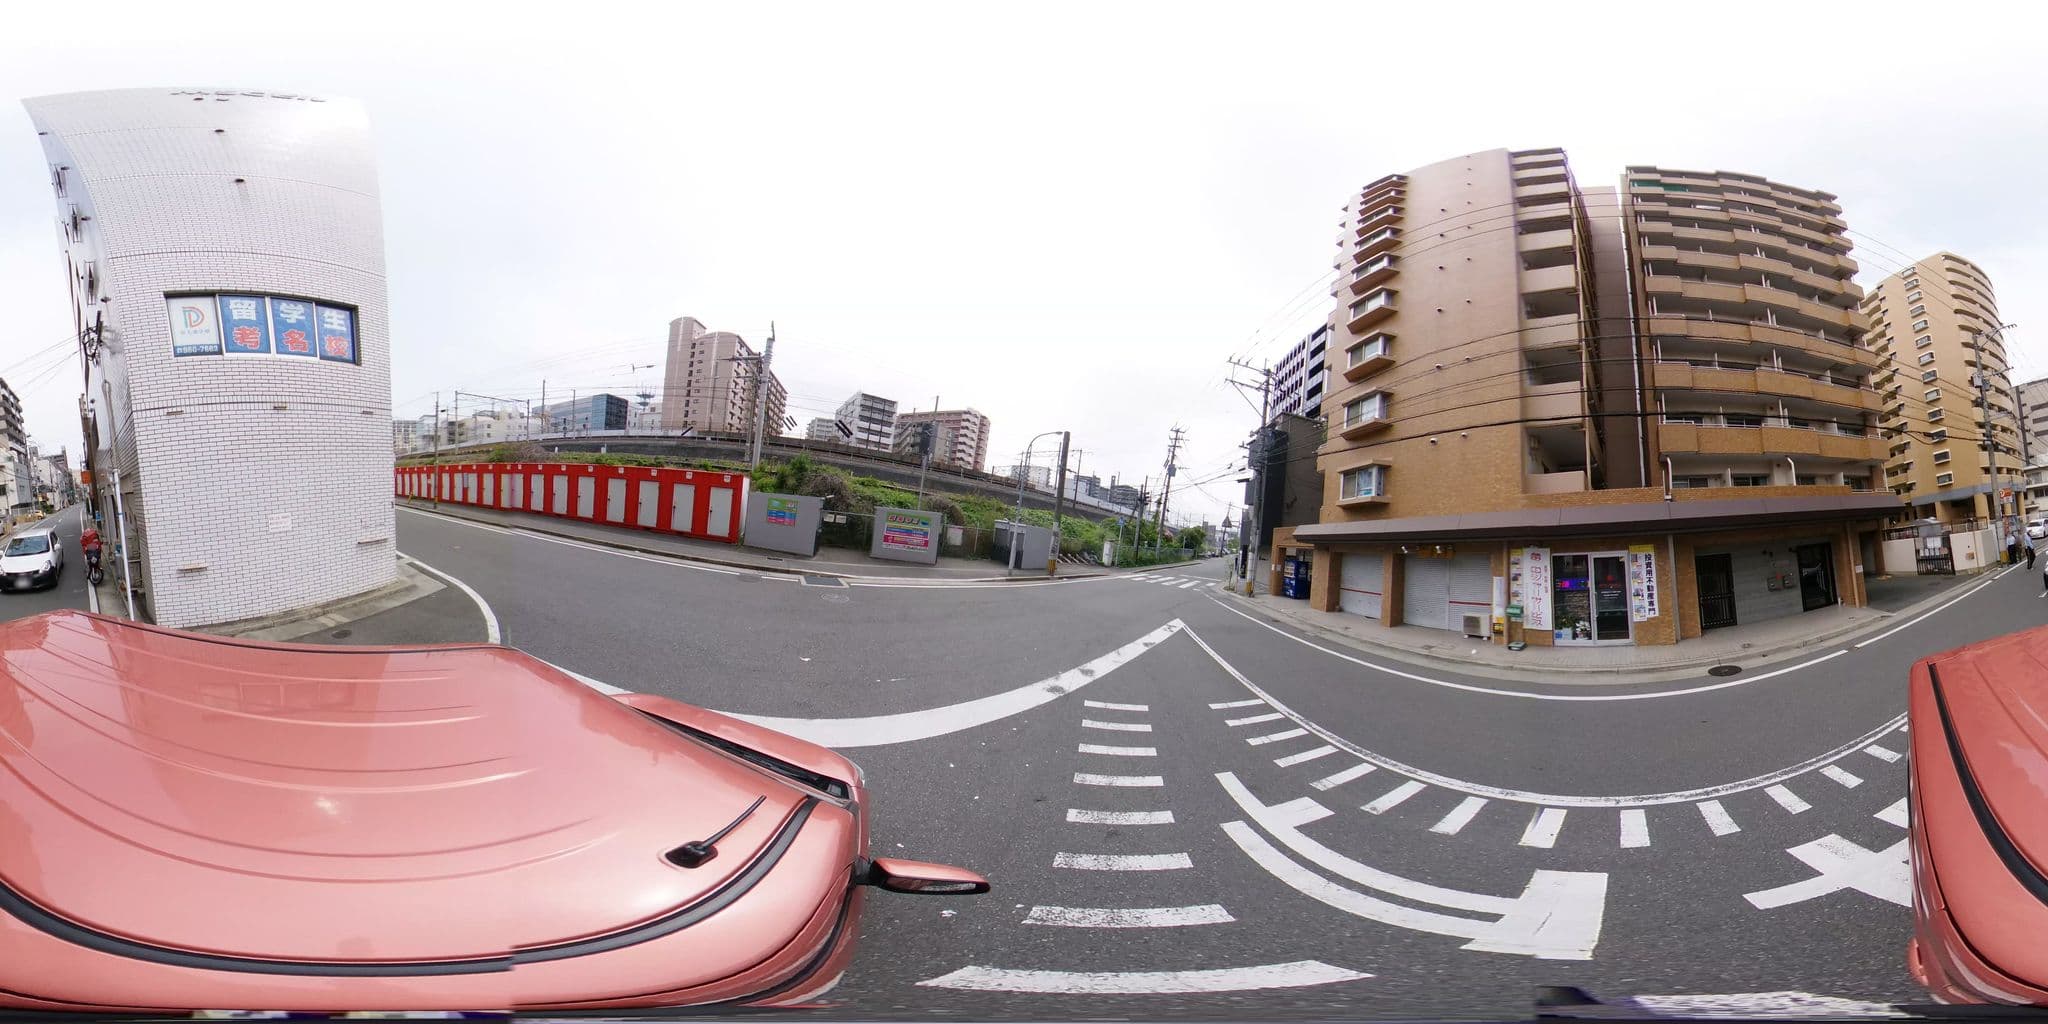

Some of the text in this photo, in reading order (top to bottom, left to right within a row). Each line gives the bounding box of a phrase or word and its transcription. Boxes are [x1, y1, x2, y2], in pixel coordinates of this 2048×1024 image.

[229, 299, 347, 331] 留学生
[232, 326, 348, 357] 考名校
[1644, 553, 1656, 615] 投資用不動産専門
